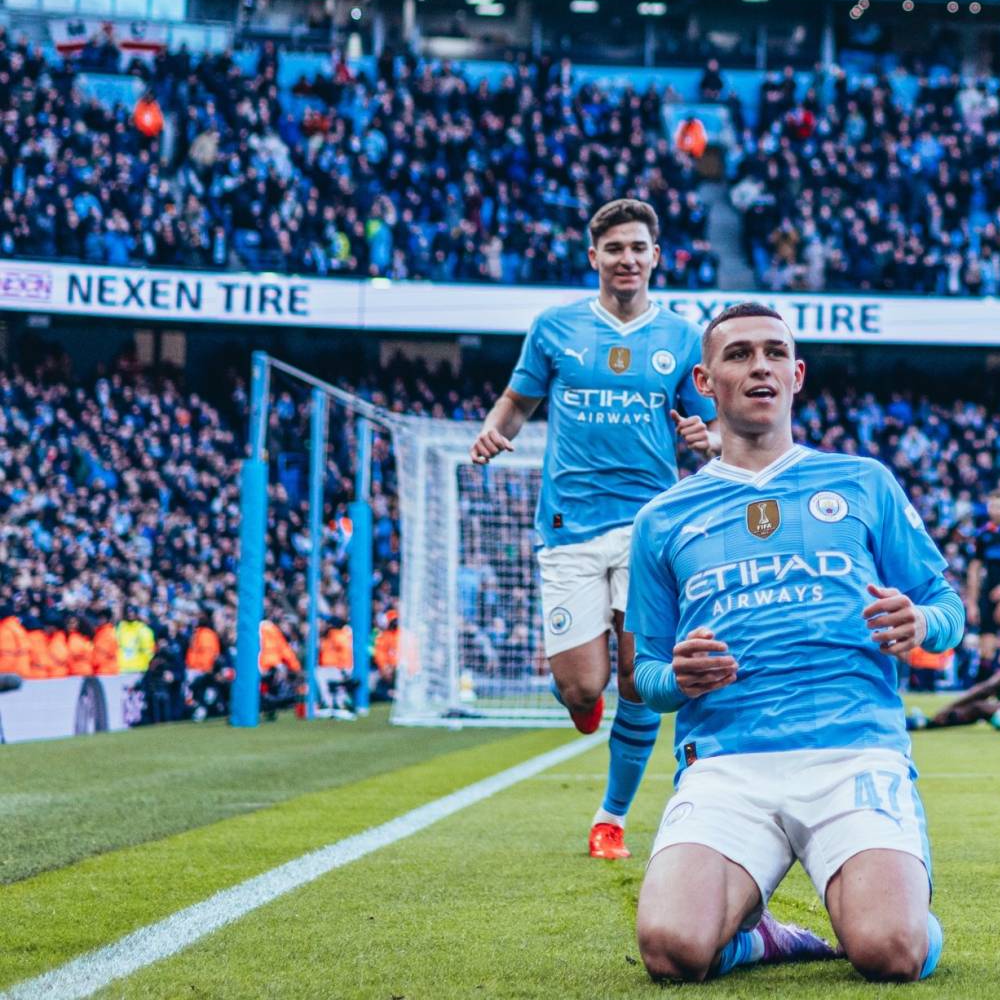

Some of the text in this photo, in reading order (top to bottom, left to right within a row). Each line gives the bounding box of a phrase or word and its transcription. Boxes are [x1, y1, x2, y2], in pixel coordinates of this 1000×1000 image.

[67, 273, 202, 311] NEXEN
[218, 281, 309, 316] TIRE
[792, 303, 880, 333] TIRE
[563, 388, 666, 409] ETIHAD
[577, 411, 651, 424] AIRWAYS
[685, 551, 853, 601] ETIHAD
[713, 585, 823, 616] AIRWAYS
[854, 769, 902, 811] 47
